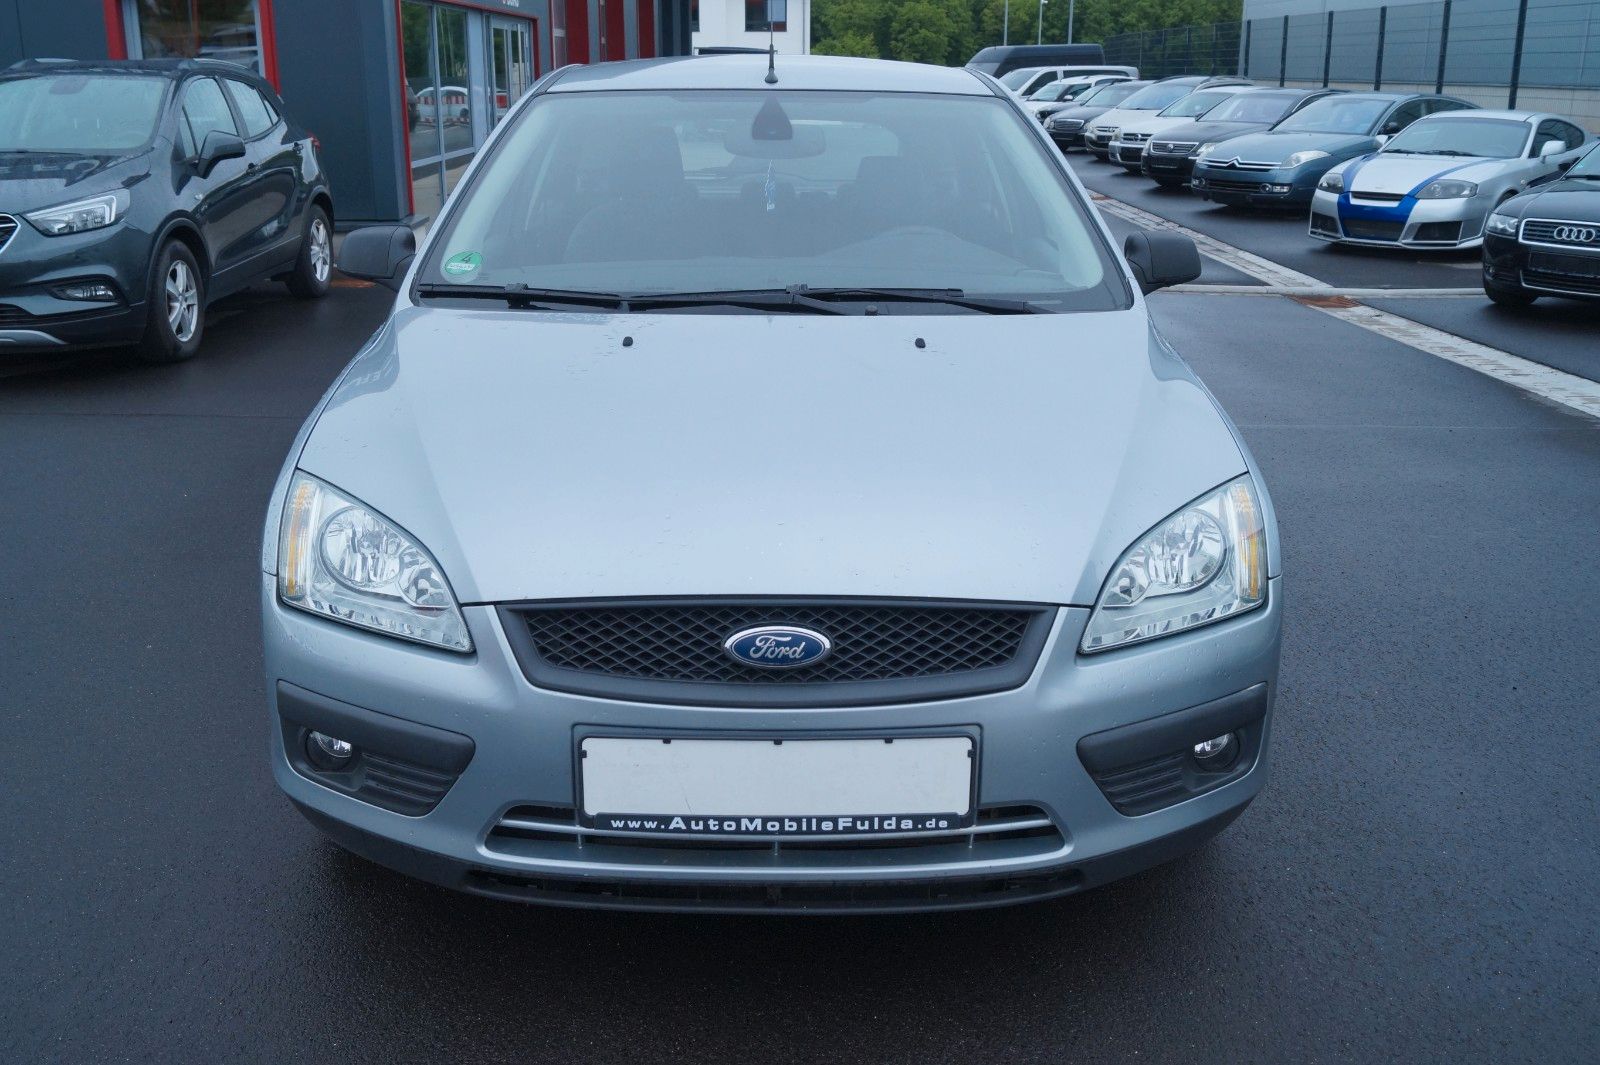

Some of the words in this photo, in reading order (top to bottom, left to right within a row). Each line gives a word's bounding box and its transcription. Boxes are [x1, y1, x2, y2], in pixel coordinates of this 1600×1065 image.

[460, 252, 474, 264] 4
[749, 635, 806, 659] Ford
[610, 816, 948, 831] www.AutoMobileFulda.de
